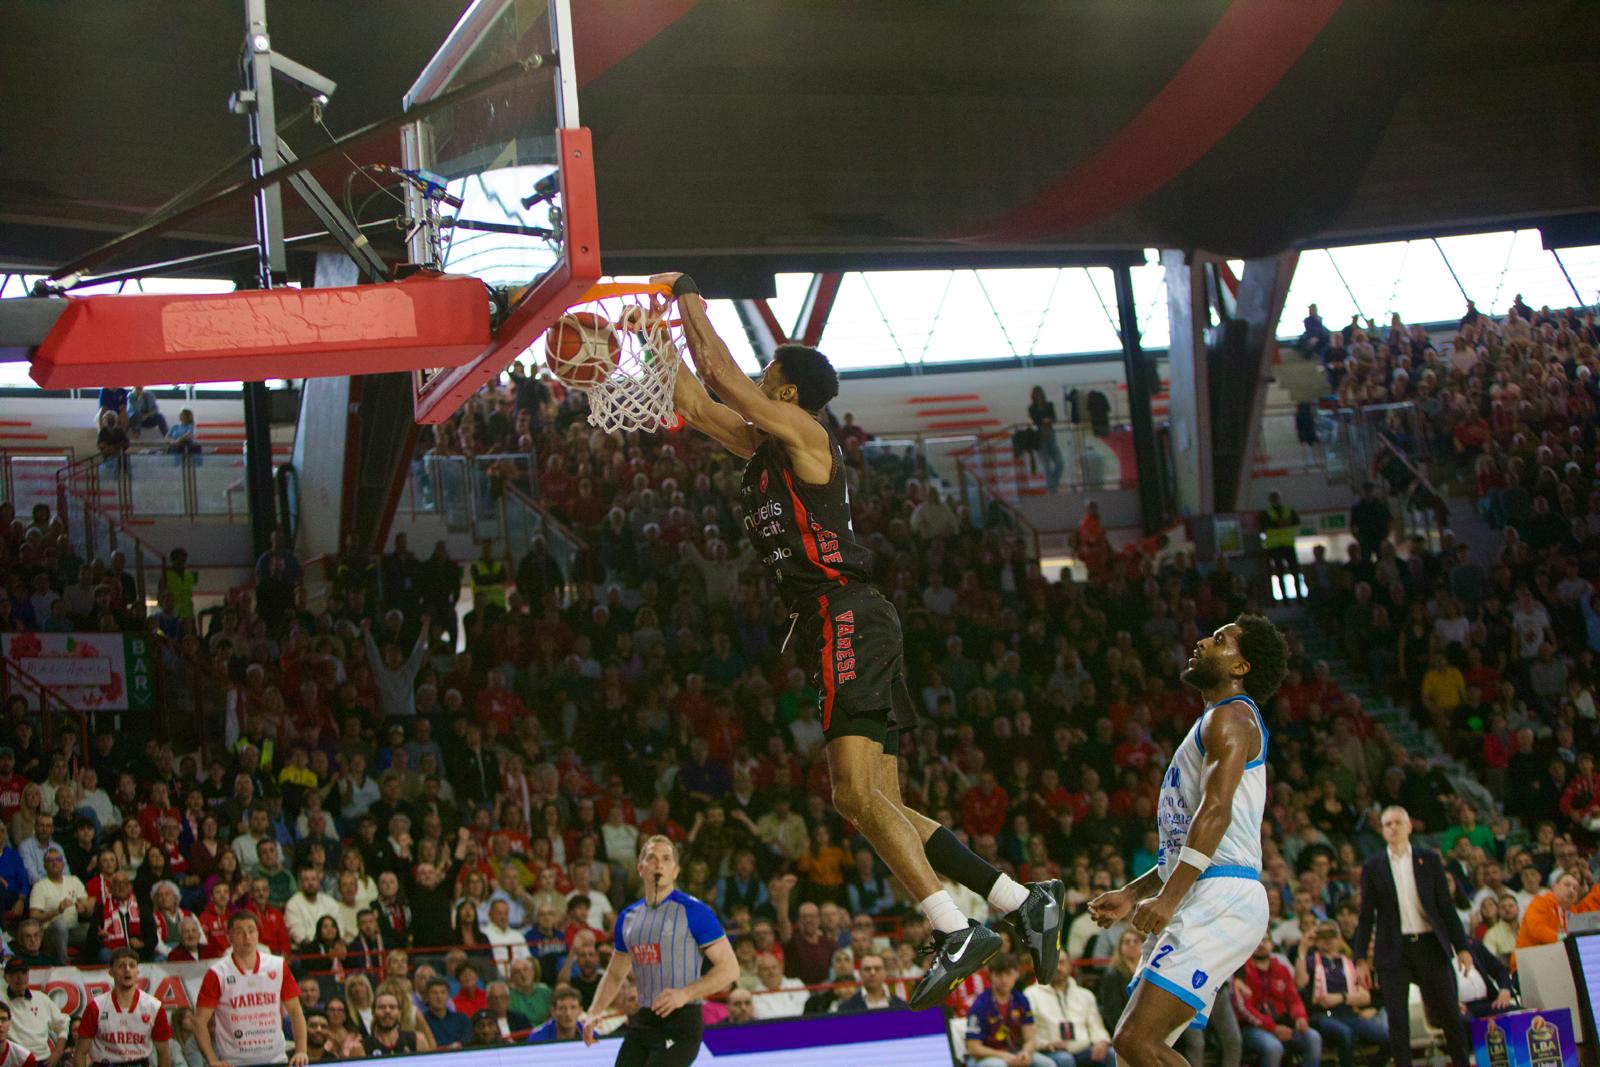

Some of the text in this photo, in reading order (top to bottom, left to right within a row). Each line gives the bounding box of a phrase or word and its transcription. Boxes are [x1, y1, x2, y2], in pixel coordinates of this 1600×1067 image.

[835, 610, 856, 684] VARESE
[132, 639, 148, 690] BAR
[1151, 945, 1173, 968] 2
[230, 992, 276, 1010] VARESE
[1532, 1040, 1556, 1054] LBA
